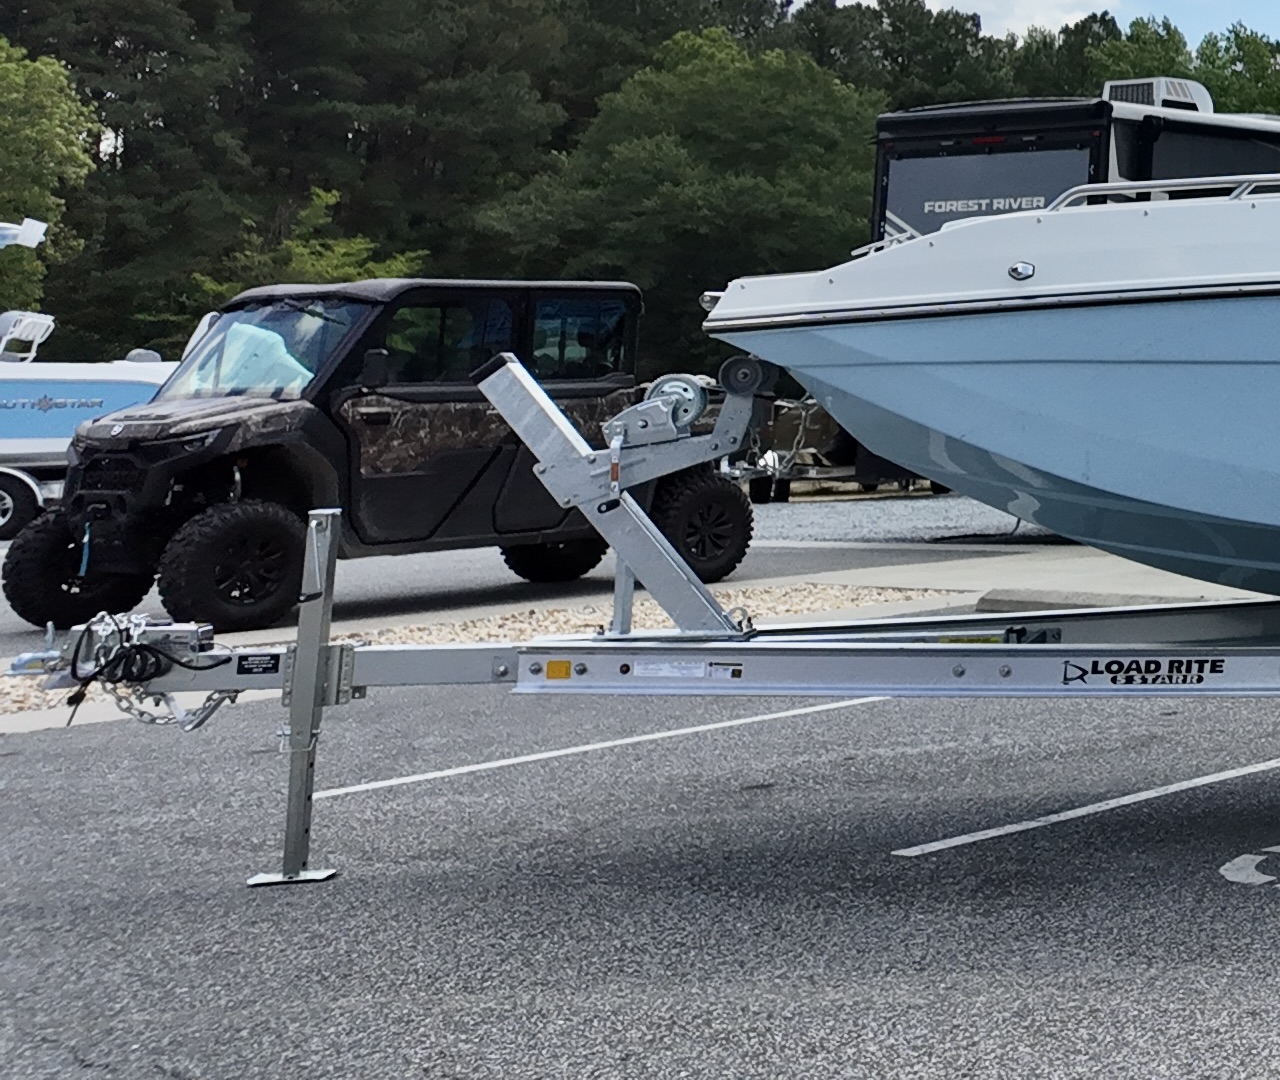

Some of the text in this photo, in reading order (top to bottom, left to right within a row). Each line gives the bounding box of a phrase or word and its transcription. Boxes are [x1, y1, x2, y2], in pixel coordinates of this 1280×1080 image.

[924, 197, 1045, 213] FOREST RIVER
[1091, 659, 1225, 675] LOAD RITE
